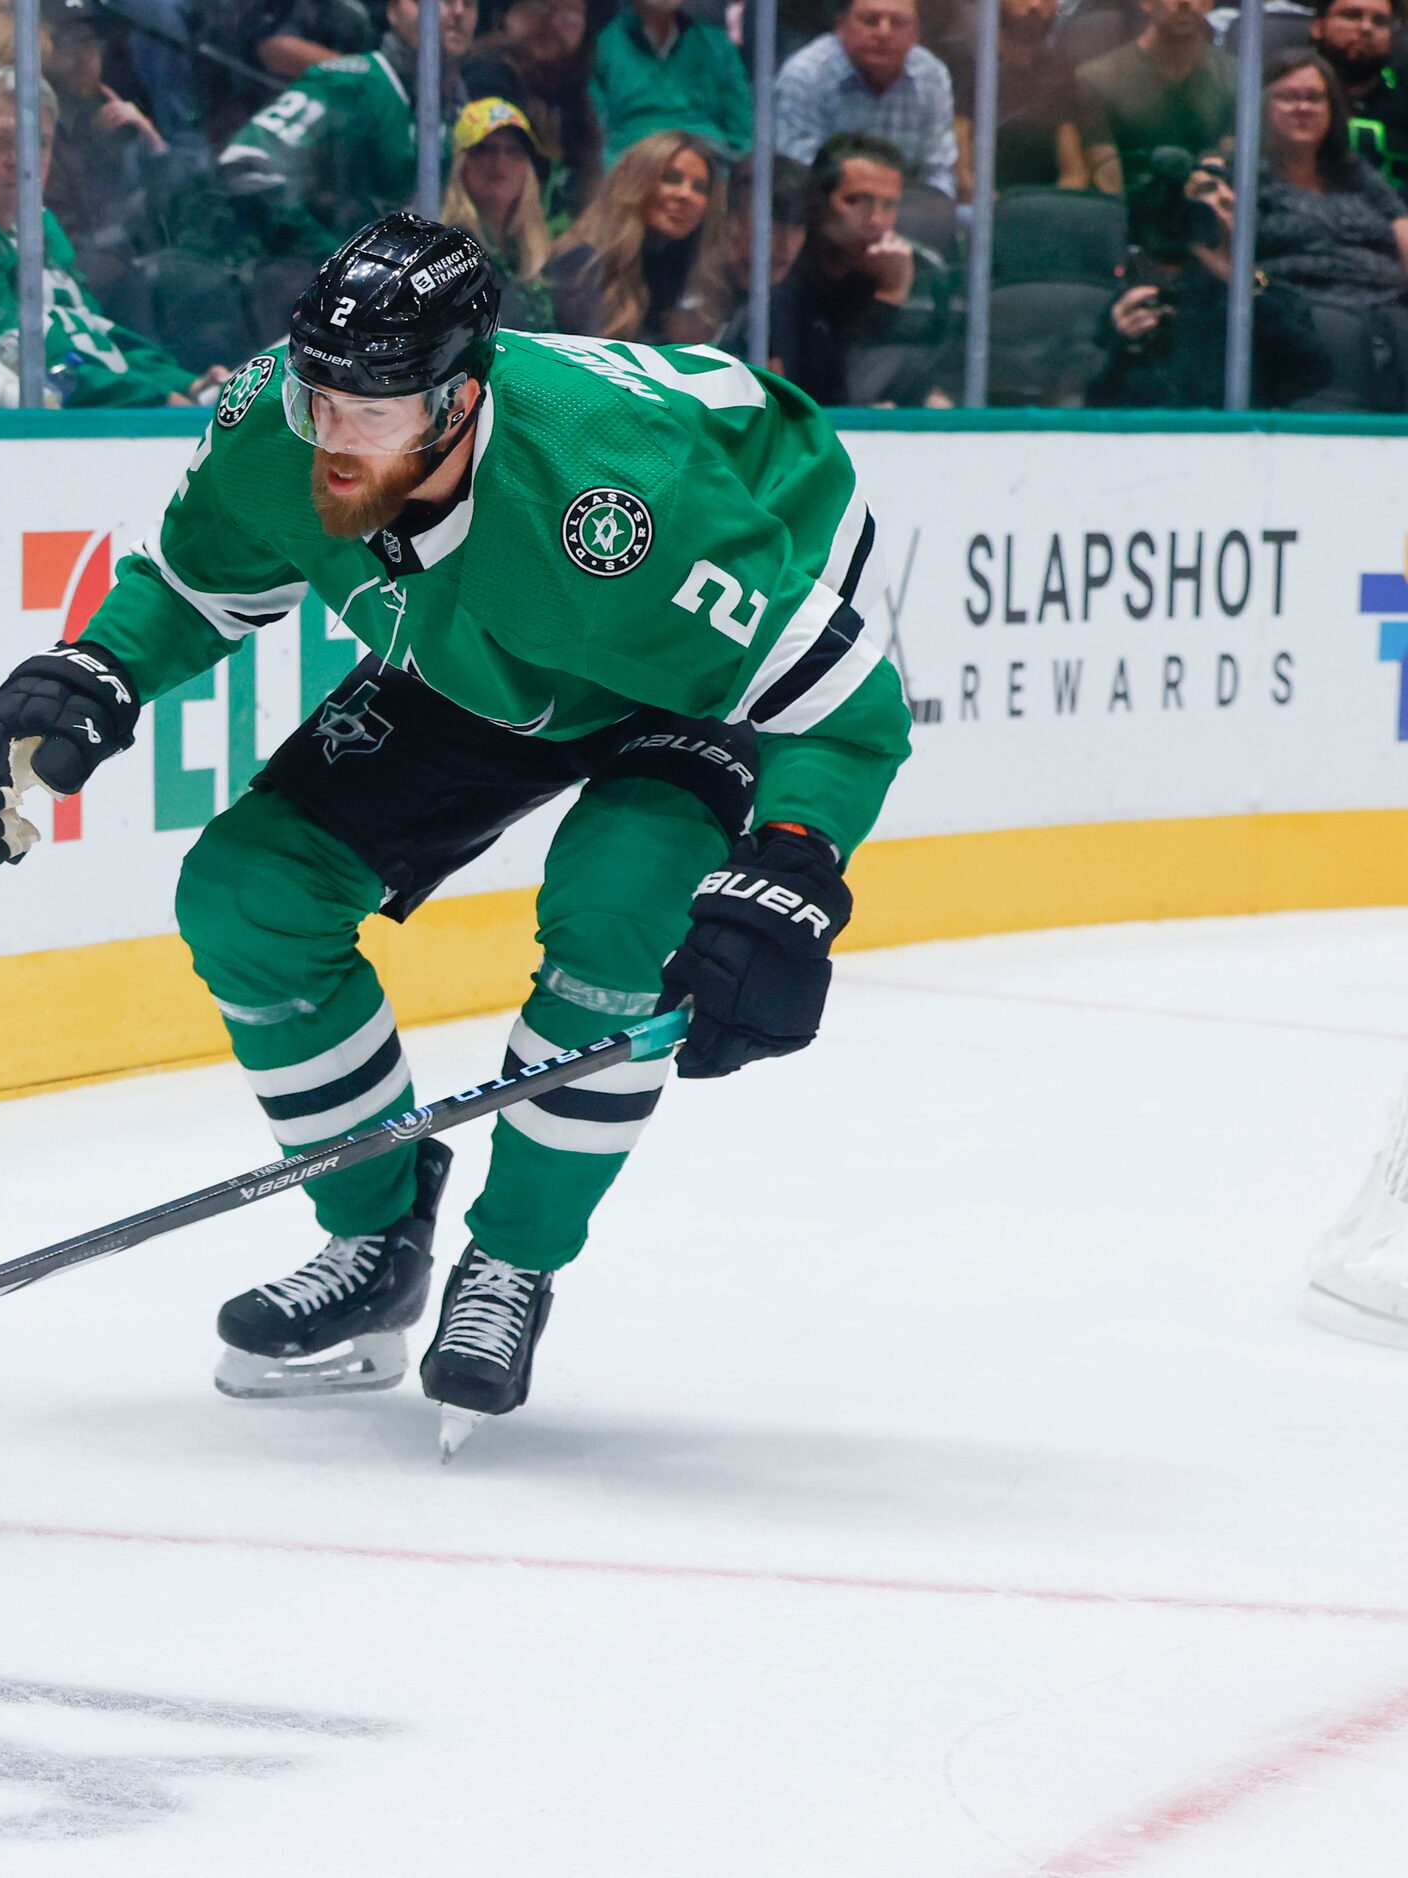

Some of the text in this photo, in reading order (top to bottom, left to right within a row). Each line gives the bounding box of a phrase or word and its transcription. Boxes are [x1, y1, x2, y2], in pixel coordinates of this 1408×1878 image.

[252, 90, 325, 145] 21
[427, 249, 465, 275] ENERGY
[434, 256, 479, 285] TRANSFER
[329, 296, 357, 328] 2
[568, 491, 648, 572] DALLAS STARS
[671, 558, 770, 649] 2
[964, 529, 1298, 627] SLAPSHOT
[959, 651, 1295, 722] REWARDS
[692, 871, 831, 940] AUER
